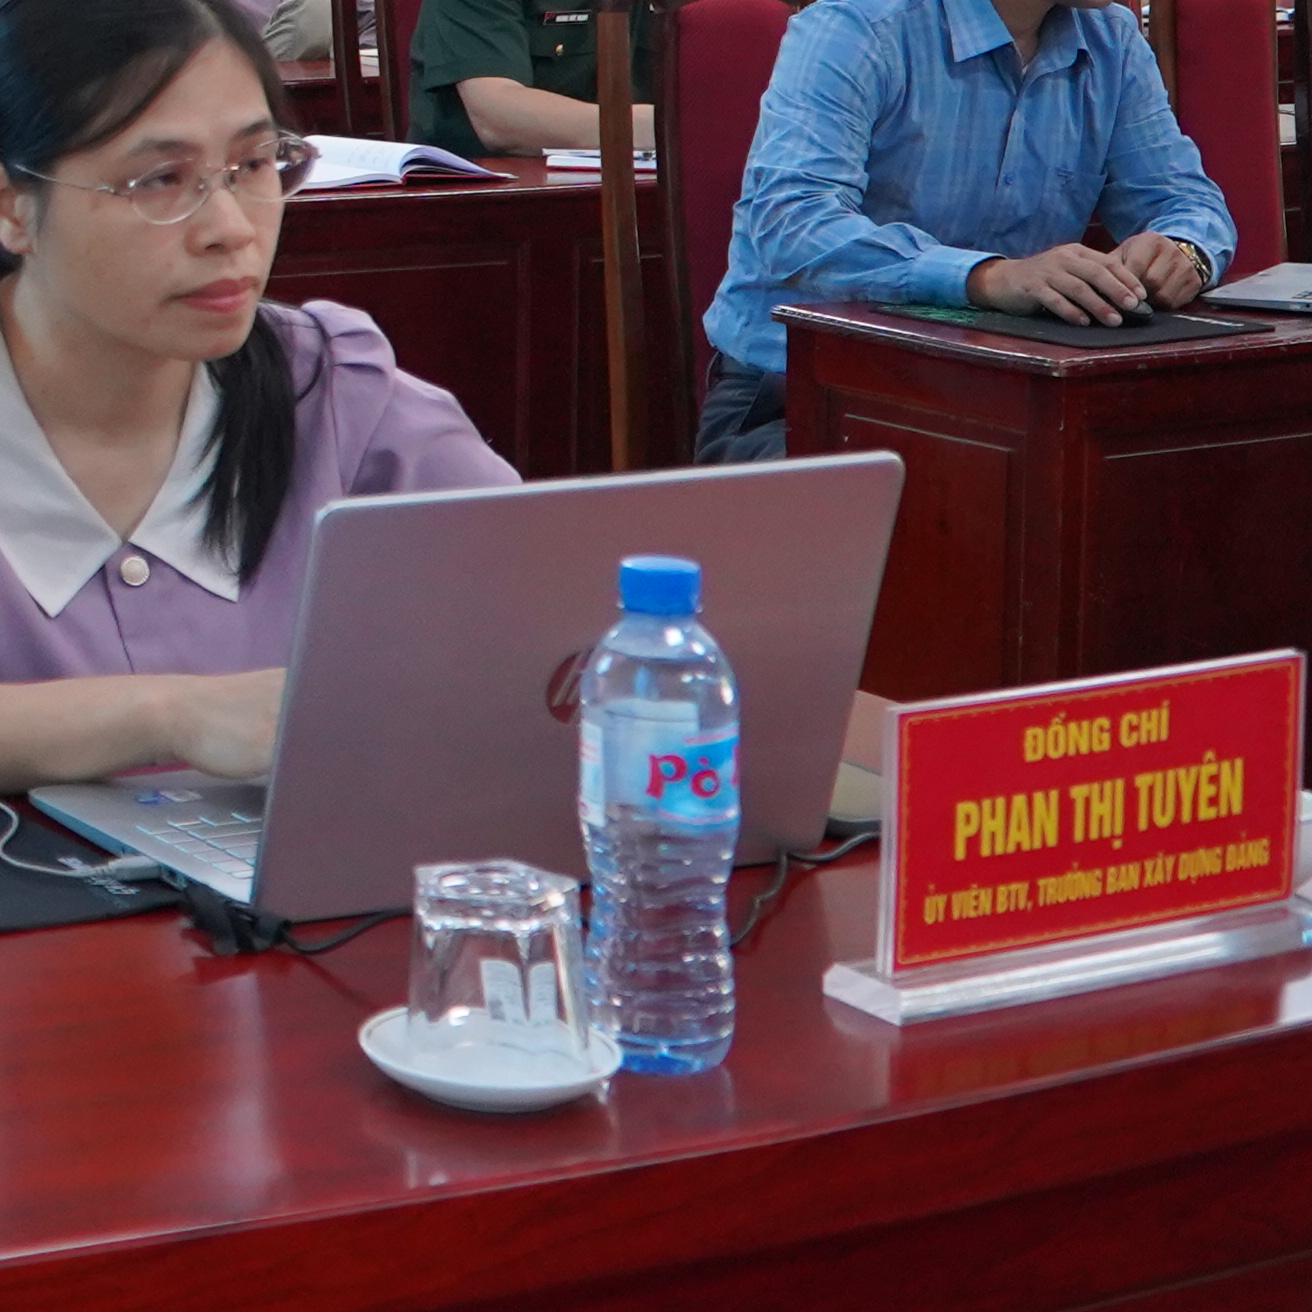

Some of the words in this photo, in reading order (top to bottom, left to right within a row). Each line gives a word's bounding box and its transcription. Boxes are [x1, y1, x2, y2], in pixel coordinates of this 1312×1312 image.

[1024, 712, 1110, 762] ĐỒNG
[1120, 700, 1170, 747] CHÍ
[954, 790, 1058, 861] PHAN
[1070, 779, 1124, 849] THỊ
[1135, 750, 1244, 831] TUYÊN
[951, 883, 993, 920] VIÊN
[1106, 862, 1141, 894] BAN
